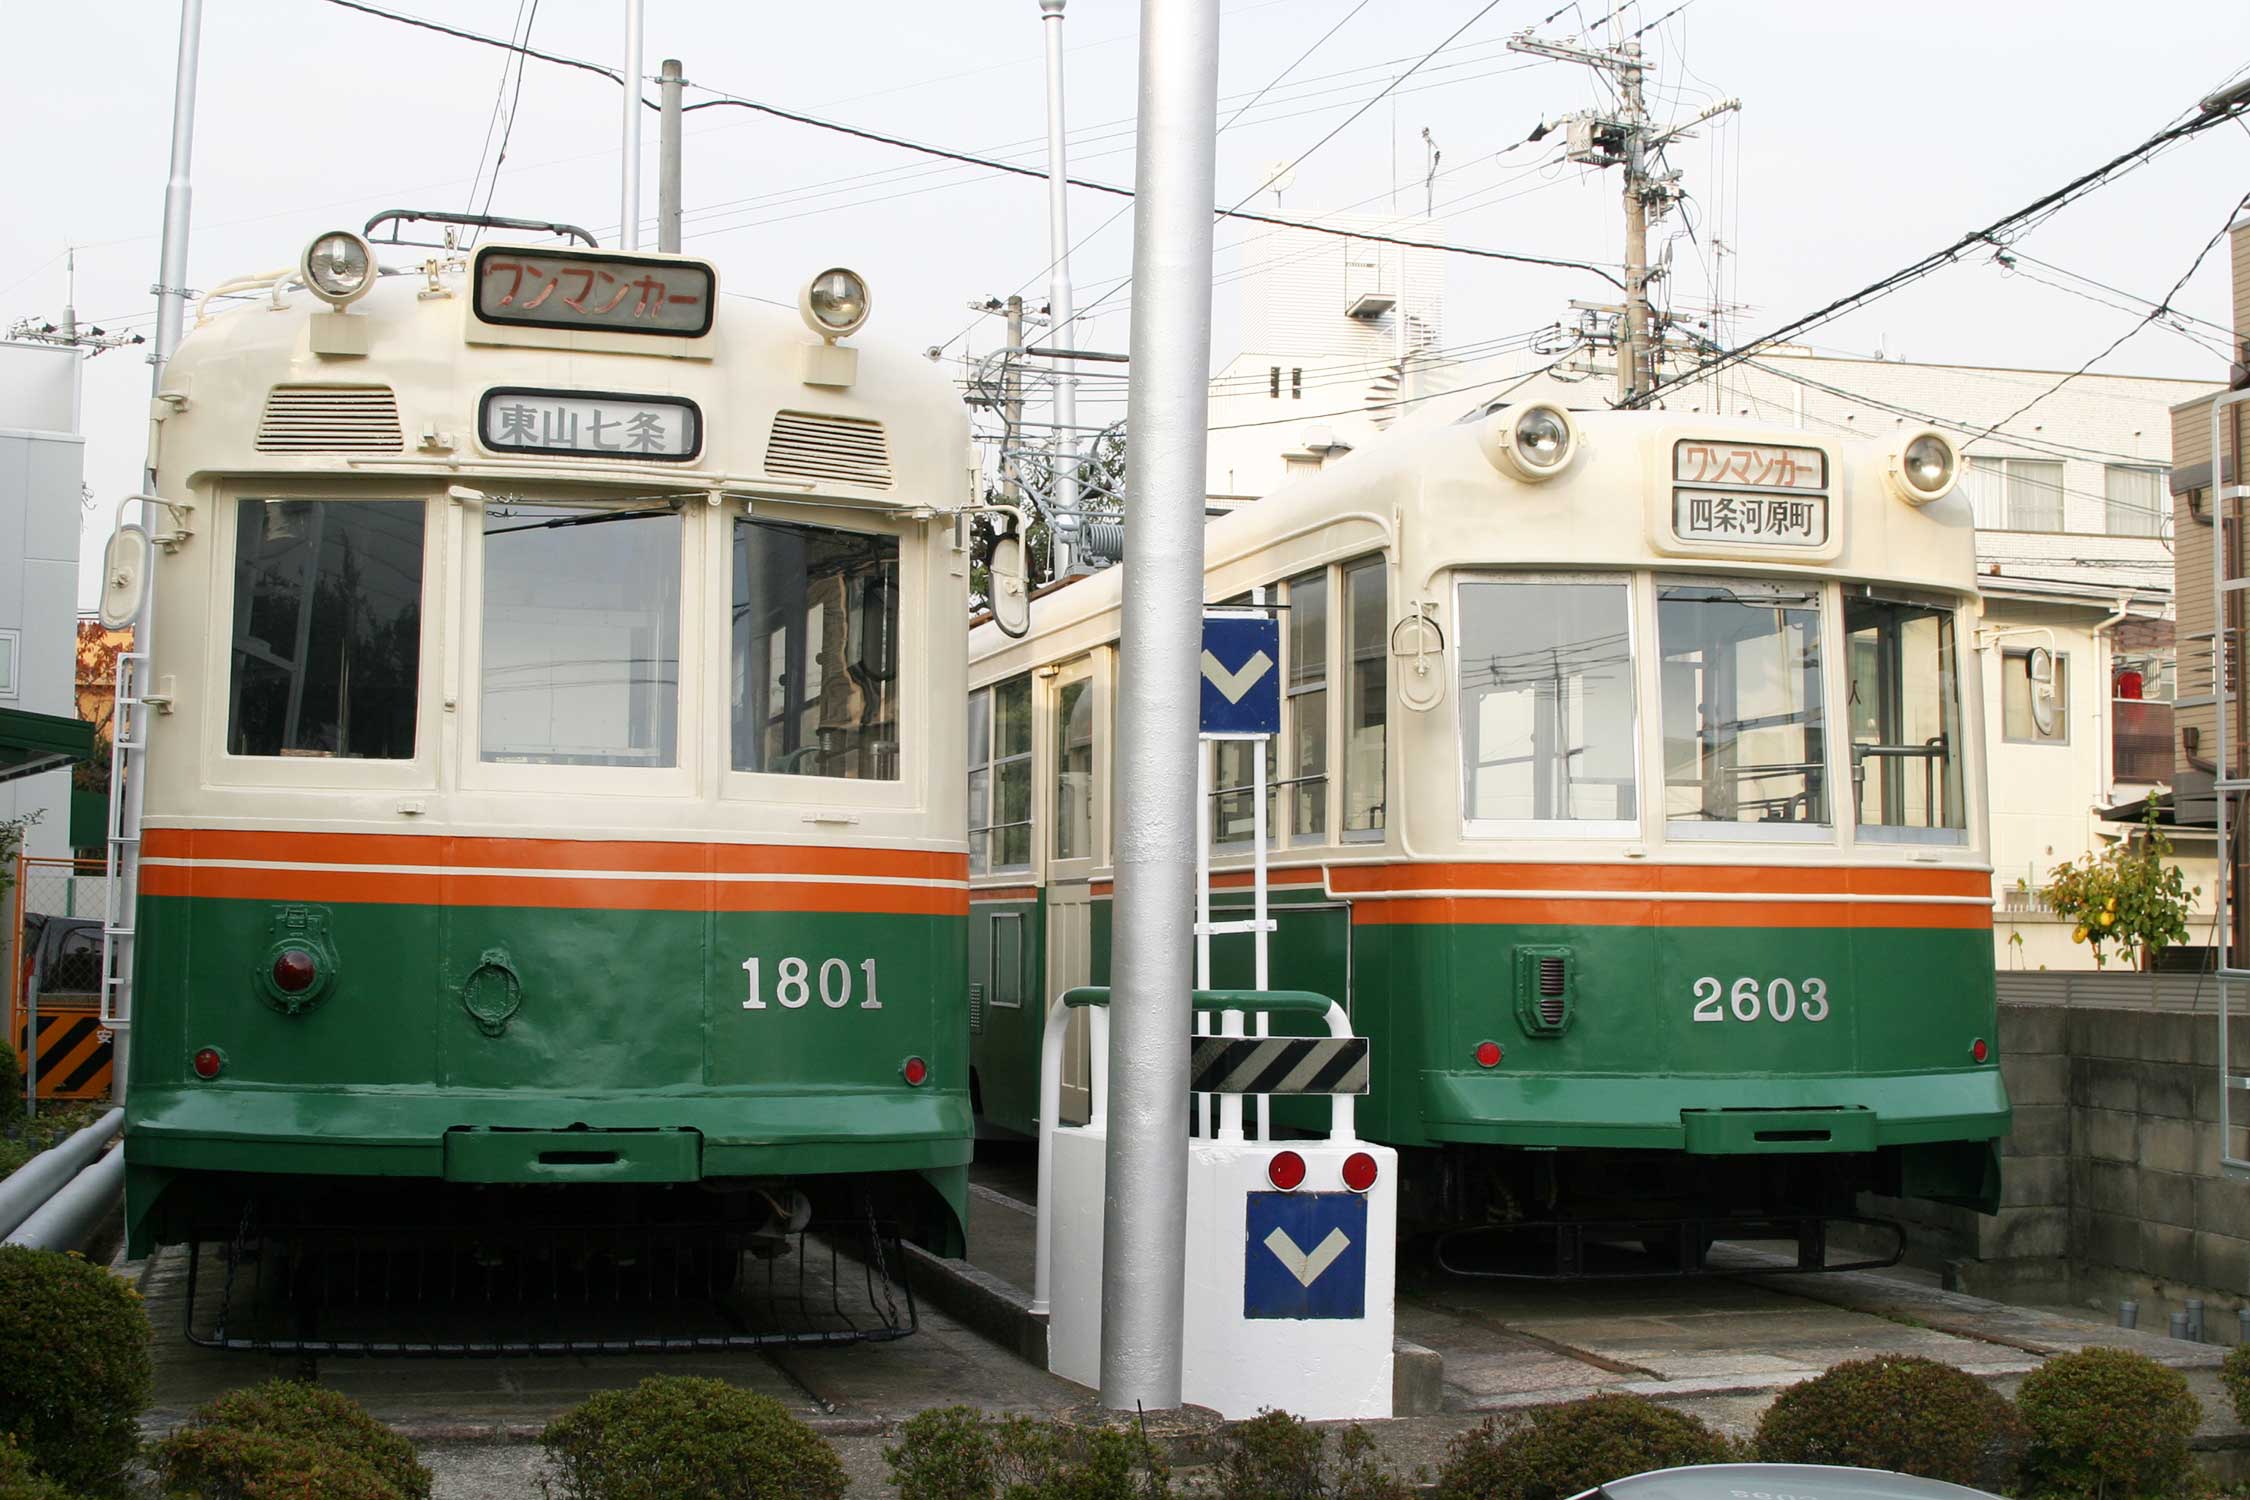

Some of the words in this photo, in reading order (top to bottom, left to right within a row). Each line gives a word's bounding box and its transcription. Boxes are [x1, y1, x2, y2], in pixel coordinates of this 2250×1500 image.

[499, 403, 667, 453] 東山七条
[1687, 447, 1813, 487] ワンマンカー
[1690, 498, 1814, 537] 四条河原町
[742, 957, 882, 1009] 1801
[1693, 976, 1829, 1022] 2603
